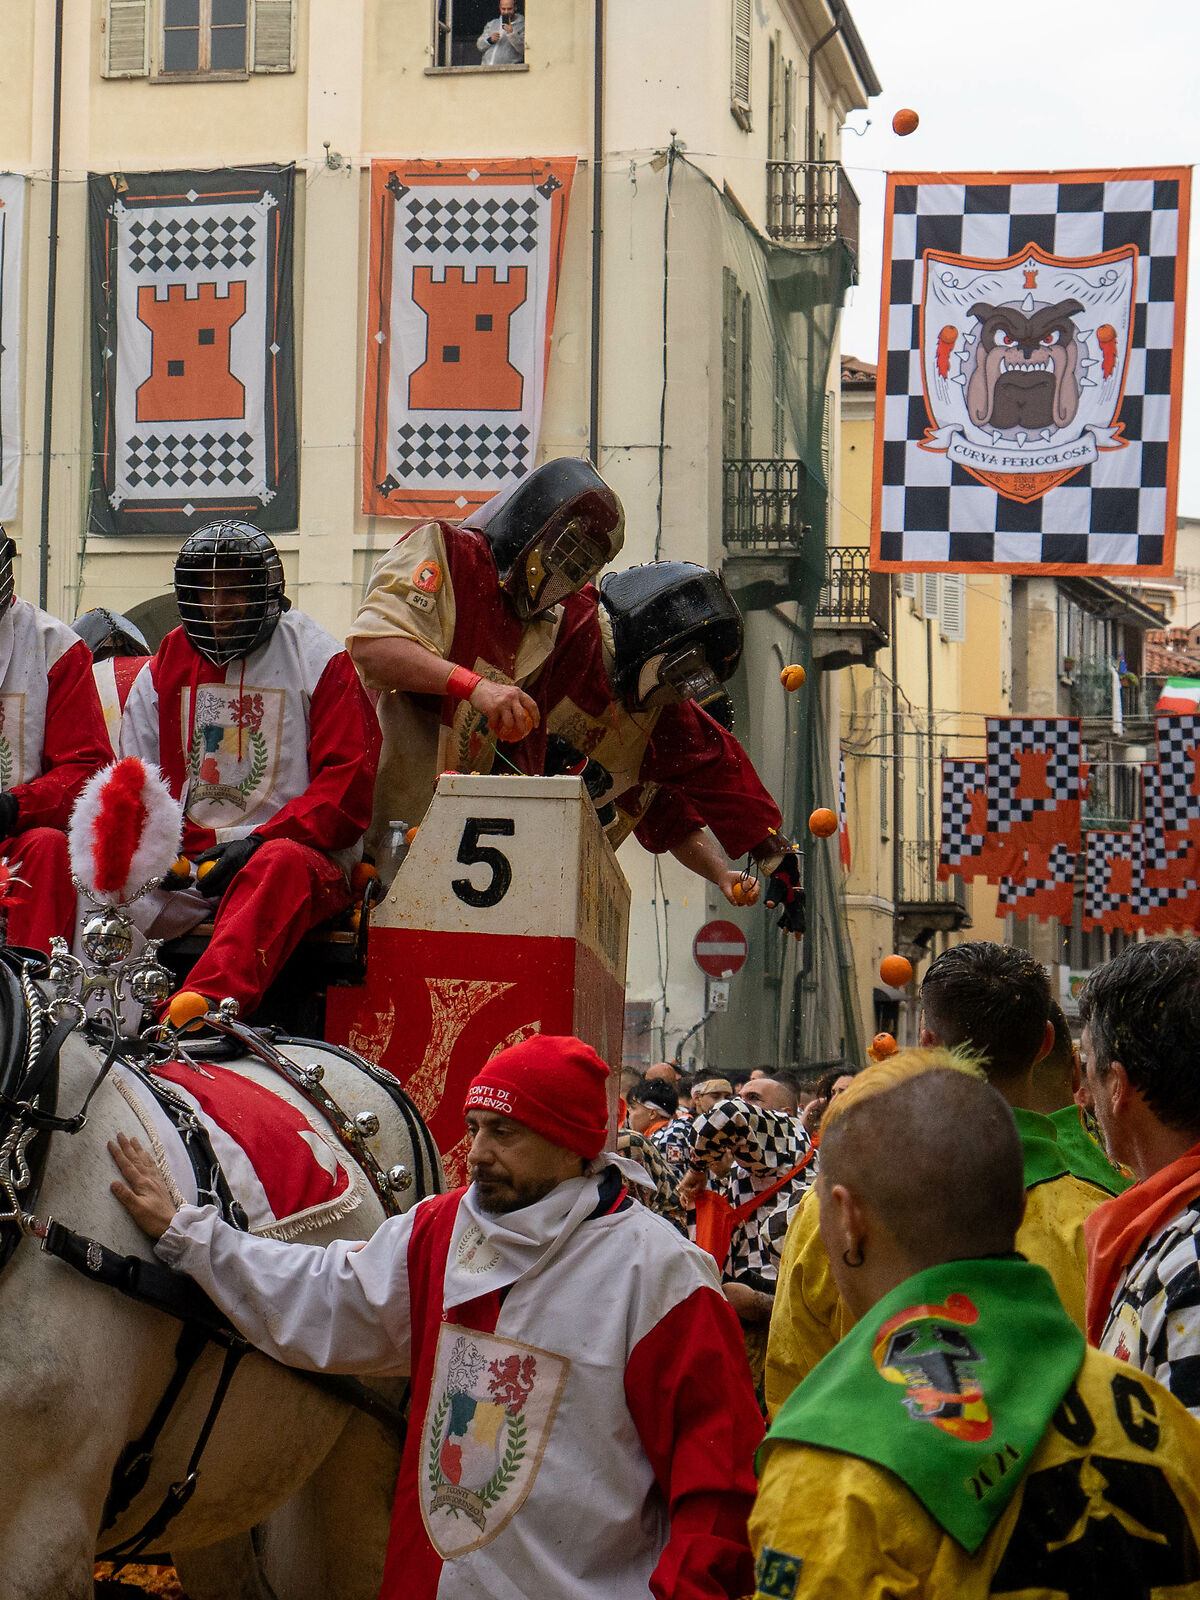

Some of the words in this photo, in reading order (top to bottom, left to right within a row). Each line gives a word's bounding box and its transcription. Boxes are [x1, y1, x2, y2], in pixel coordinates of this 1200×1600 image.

[953, 444, 998, 465] CURVA
[1001, 445, 1092, 467] PERICOLOSA
[451, 816, 515, 909] 5
[467, 1095, 513, 1114] LORENZO
[496, 1088, 510, 1101] DI
